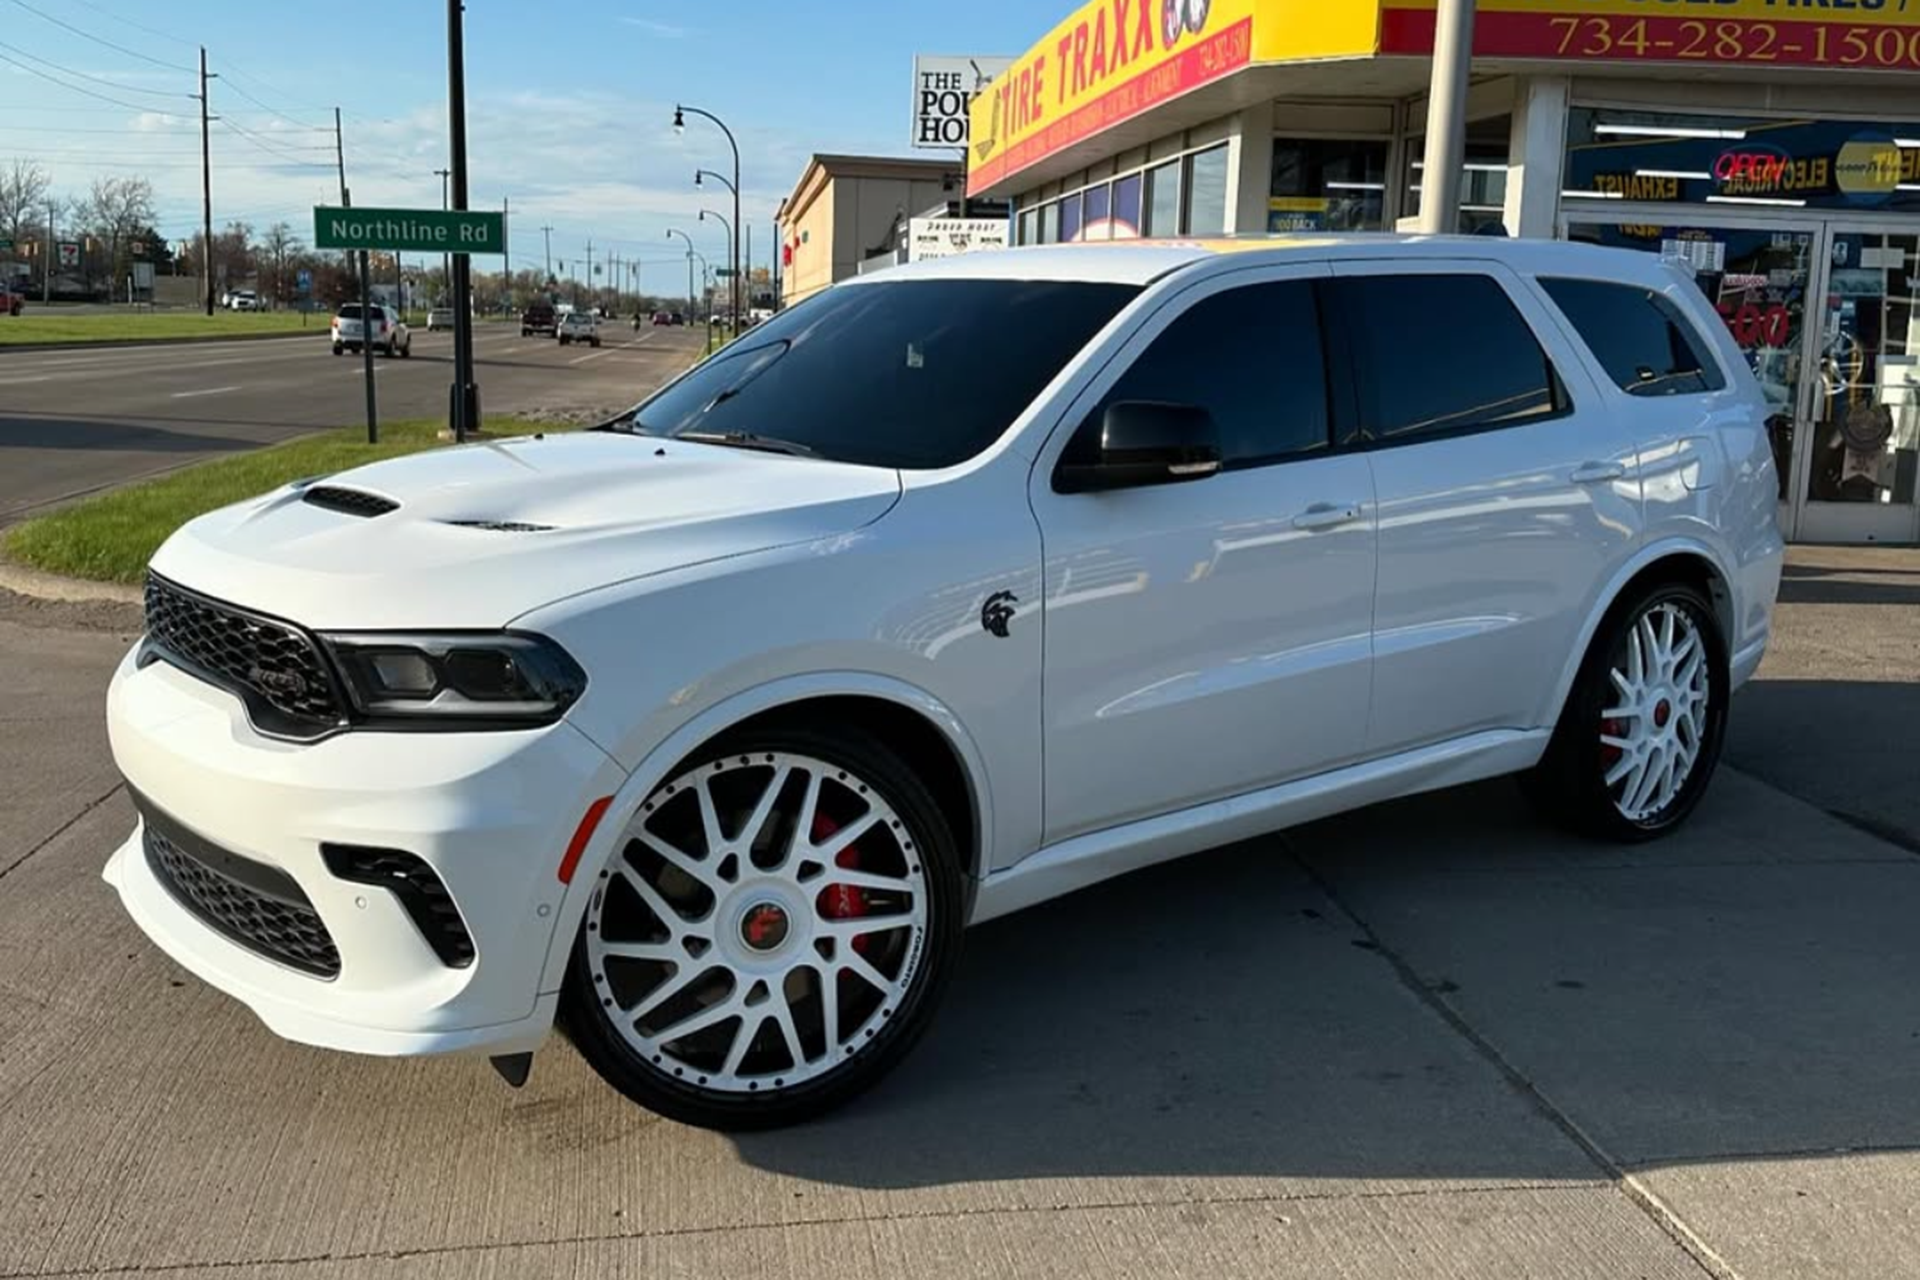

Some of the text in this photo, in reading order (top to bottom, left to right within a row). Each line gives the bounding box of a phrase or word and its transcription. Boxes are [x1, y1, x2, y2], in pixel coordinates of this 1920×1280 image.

[921, 71, 962, 90] THE
[1001, 55, 1045, 141] TIRE
[1057, 0, 1154, 106] TRAXX
[919, 90, 976, 117] POU
[918, 117, 970, 143] HO
[1714, 152, 1788, 184] OPEN
[331, 219, 488, 242] Northline Rd
